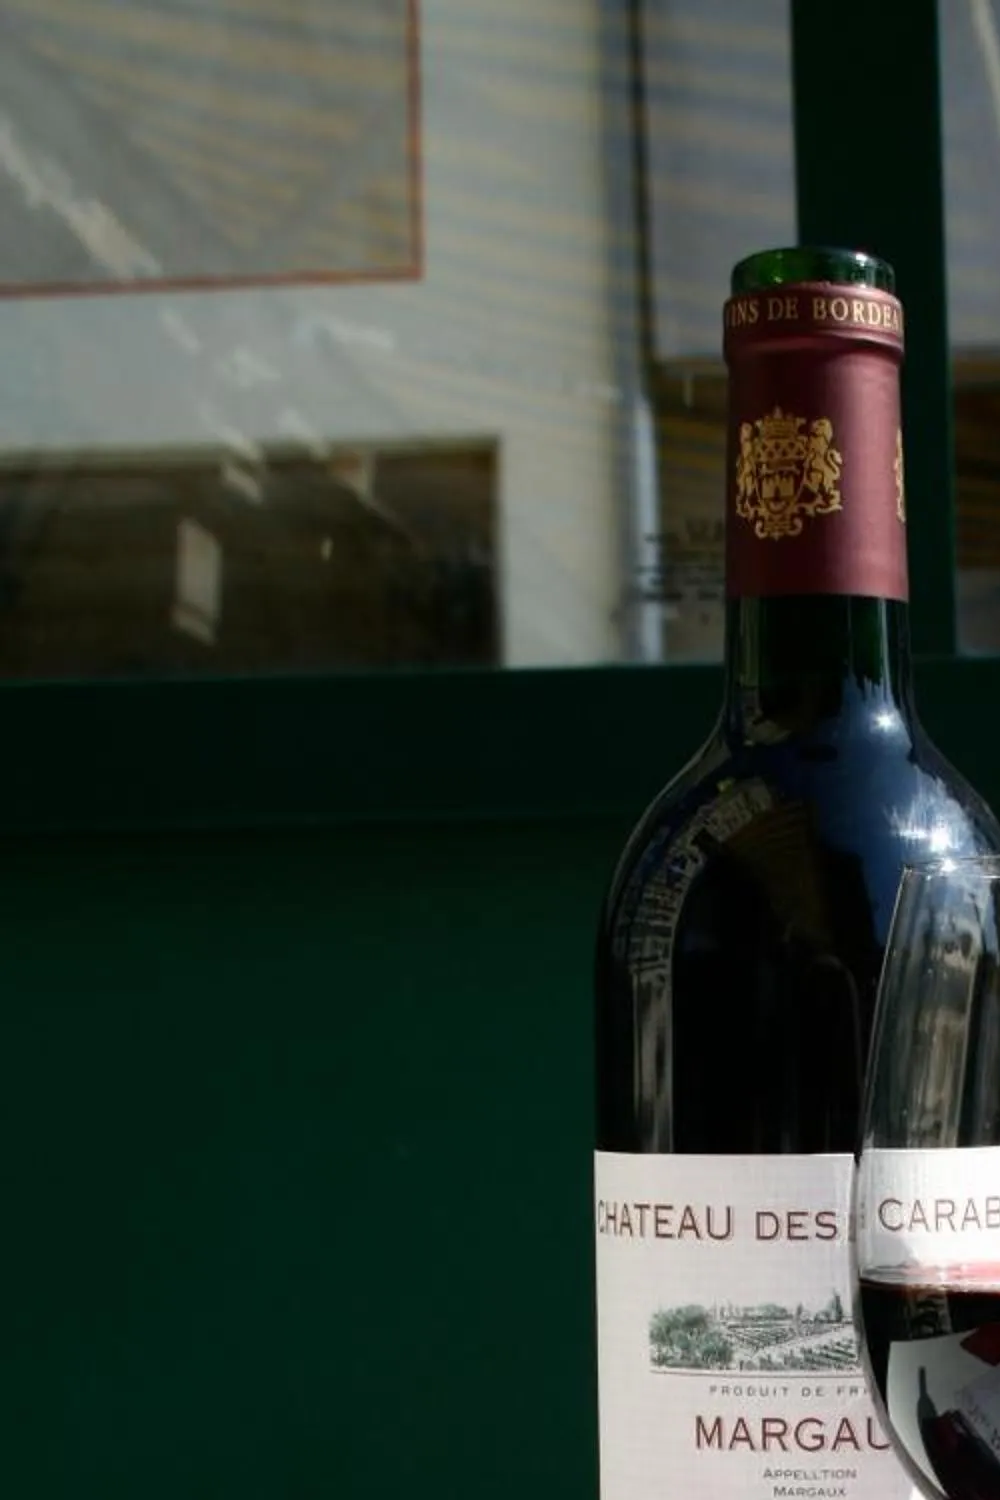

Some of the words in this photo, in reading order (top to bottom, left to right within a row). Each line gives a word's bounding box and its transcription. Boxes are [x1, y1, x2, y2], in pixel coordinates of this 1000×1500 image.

[731, 300, 759, 327] INS
[767, 297, 799, 320] DE
[812, 297, 902, 328] BORDEA
[598, 1199, 733, 1240] CHATEAU
[755, 1210, 838, 1242] DES
[709, 1385, 789, 1397] PRODUIT
[801, 1386, 825, 1397] DE
[695, 1414, 891, 1453] MARGAU
[773, 1486, 848, 1498] MARGAUX
